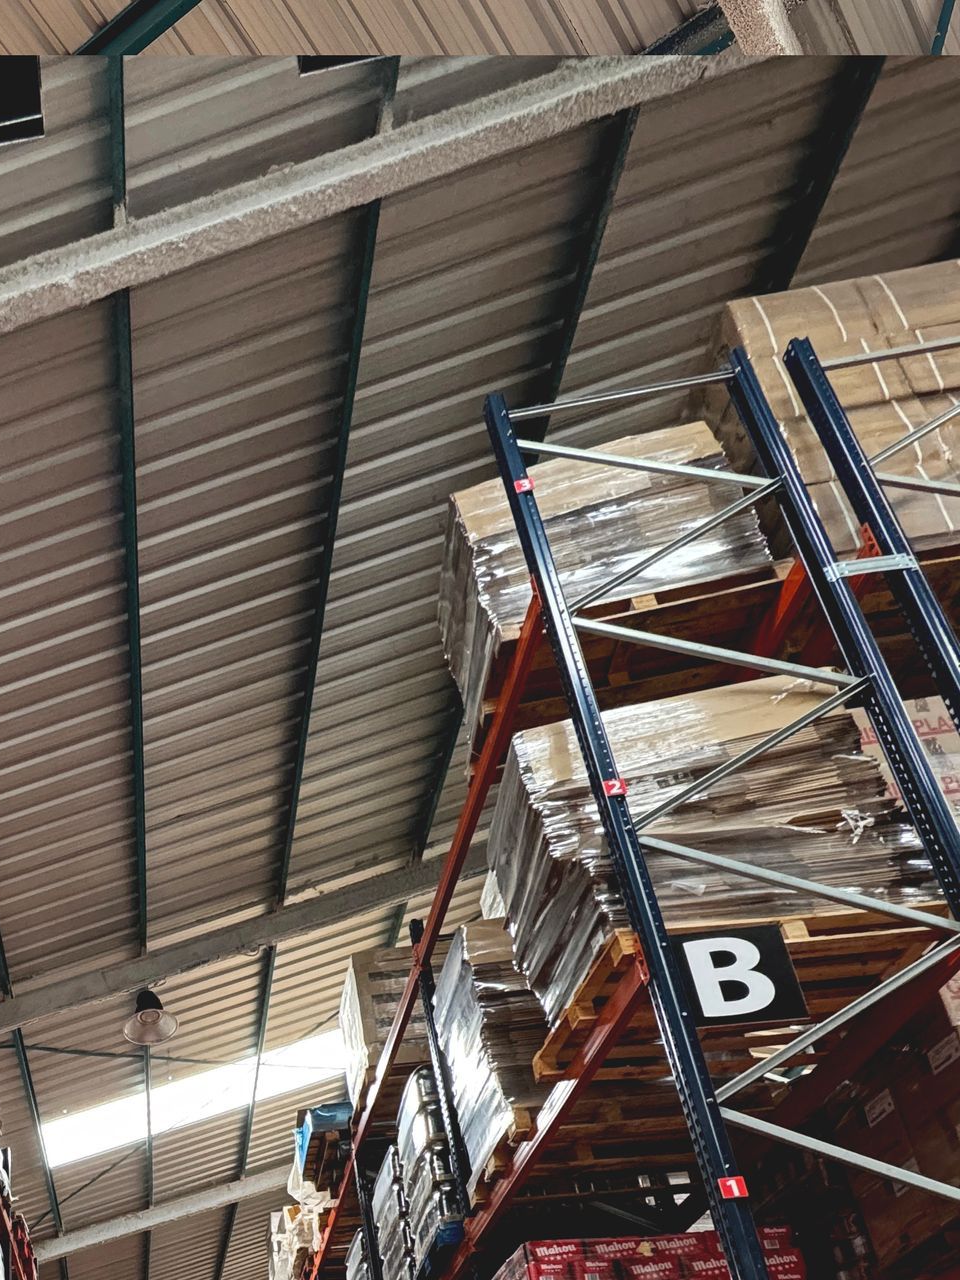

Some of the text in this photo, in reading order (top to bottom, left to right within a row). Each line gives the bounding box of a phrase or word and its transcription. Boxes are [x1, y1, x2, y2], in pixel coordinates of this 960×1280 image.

[519, 480, 531, 491] 3
[608, 781, 623, 794] 2
[682, 936, 776, 1018] B
[724, 1179, 740, 1197] 1
[692, 1258, 727, 1271] Maho
